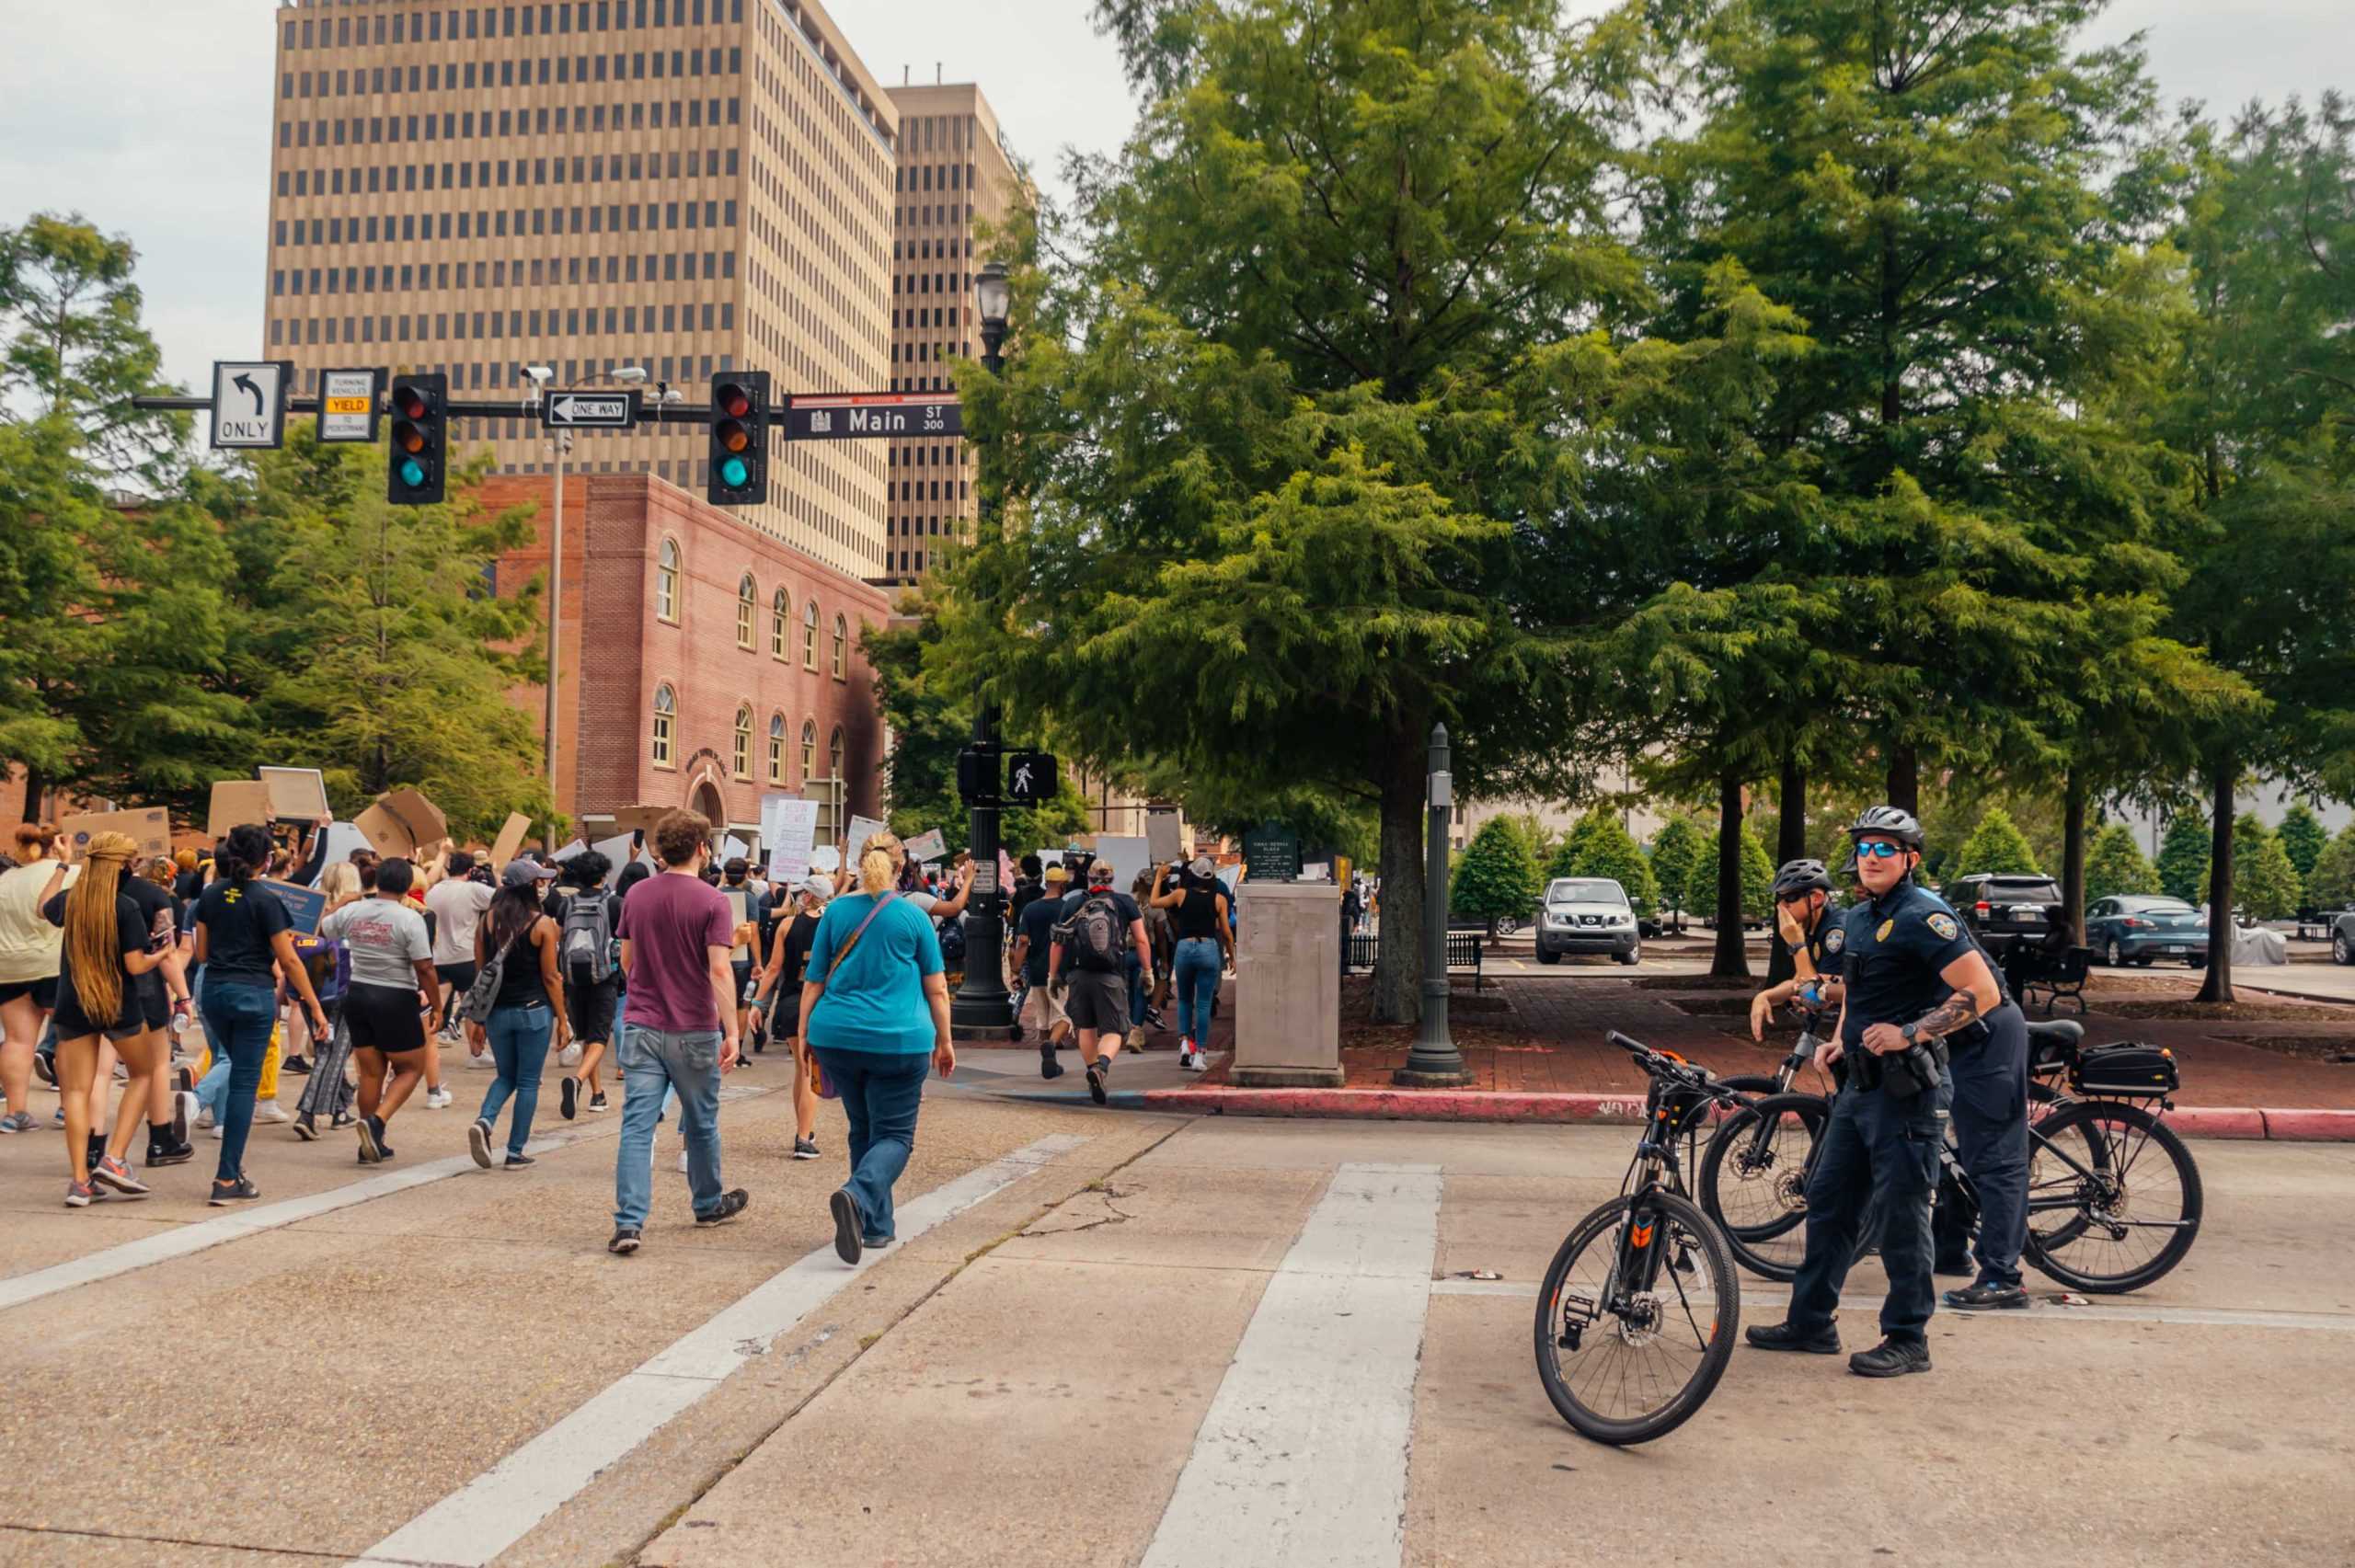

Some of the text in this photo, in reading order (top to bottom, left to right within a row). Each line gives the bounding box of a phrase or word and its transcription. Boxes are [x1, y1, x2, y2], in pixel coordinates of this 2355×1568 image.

[333, 399, 364, 411] YIELD
[573, 404, 620, 416] ONE WAY
[849, 406, 943, 431] Main ST
[923, 419, 944, 430] 300
[222, 421, 269, 438] ONLY
